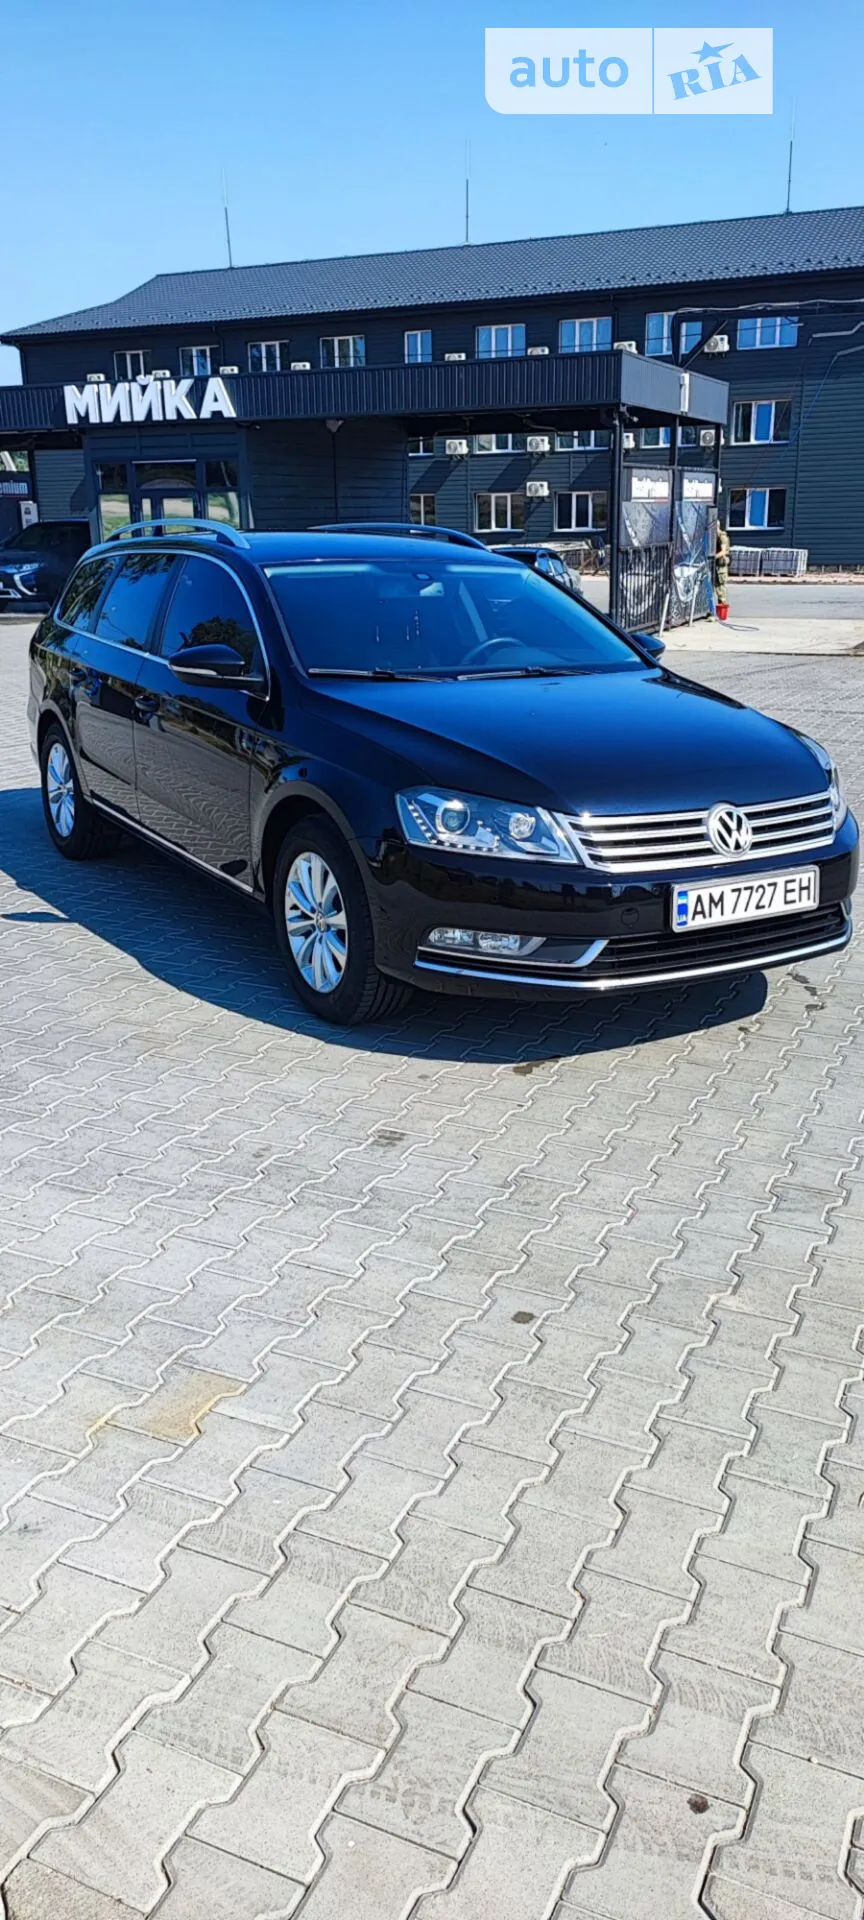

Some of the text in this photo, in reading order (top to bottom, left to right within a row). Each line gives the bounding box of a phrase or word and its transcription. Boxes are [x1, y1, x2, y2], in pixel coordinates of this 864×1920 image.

[63, 375, 237, 424] МИЙКА
[691, 876, 811, 921] AM 7727 EH
